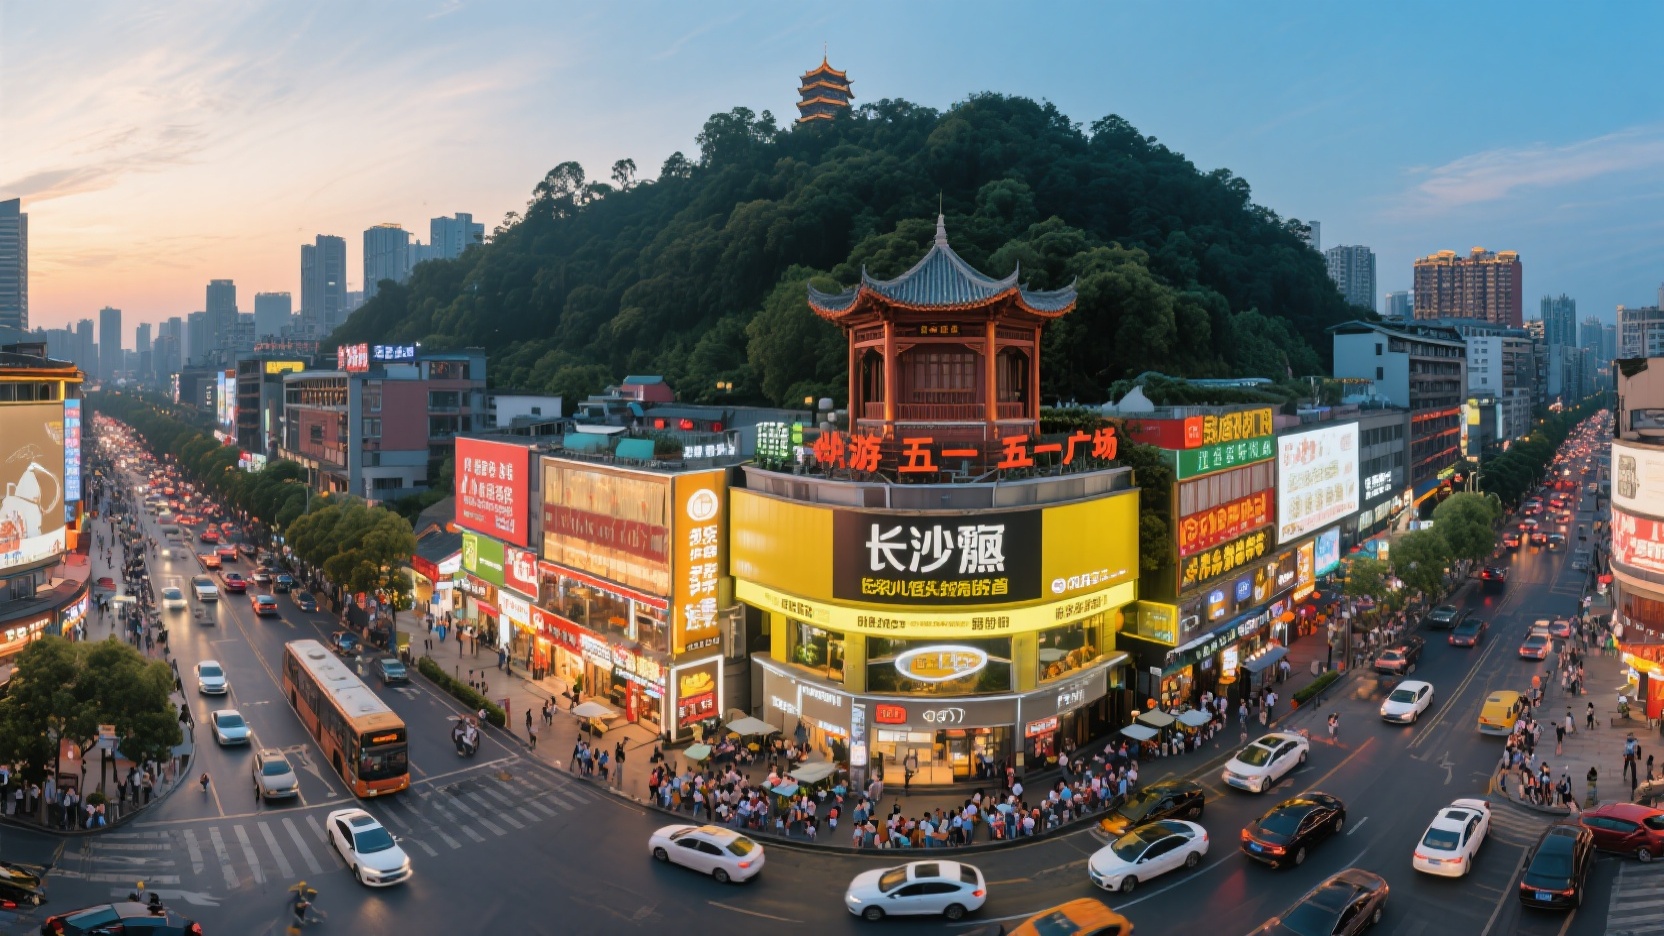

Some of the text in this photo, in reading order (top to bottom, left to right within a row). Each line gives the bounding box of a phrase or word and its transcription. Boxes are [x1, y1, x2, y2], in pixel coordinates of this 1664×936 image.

[898, 437, 978, 473] 五一
[998, 427, 1118, 469] 五一广场
